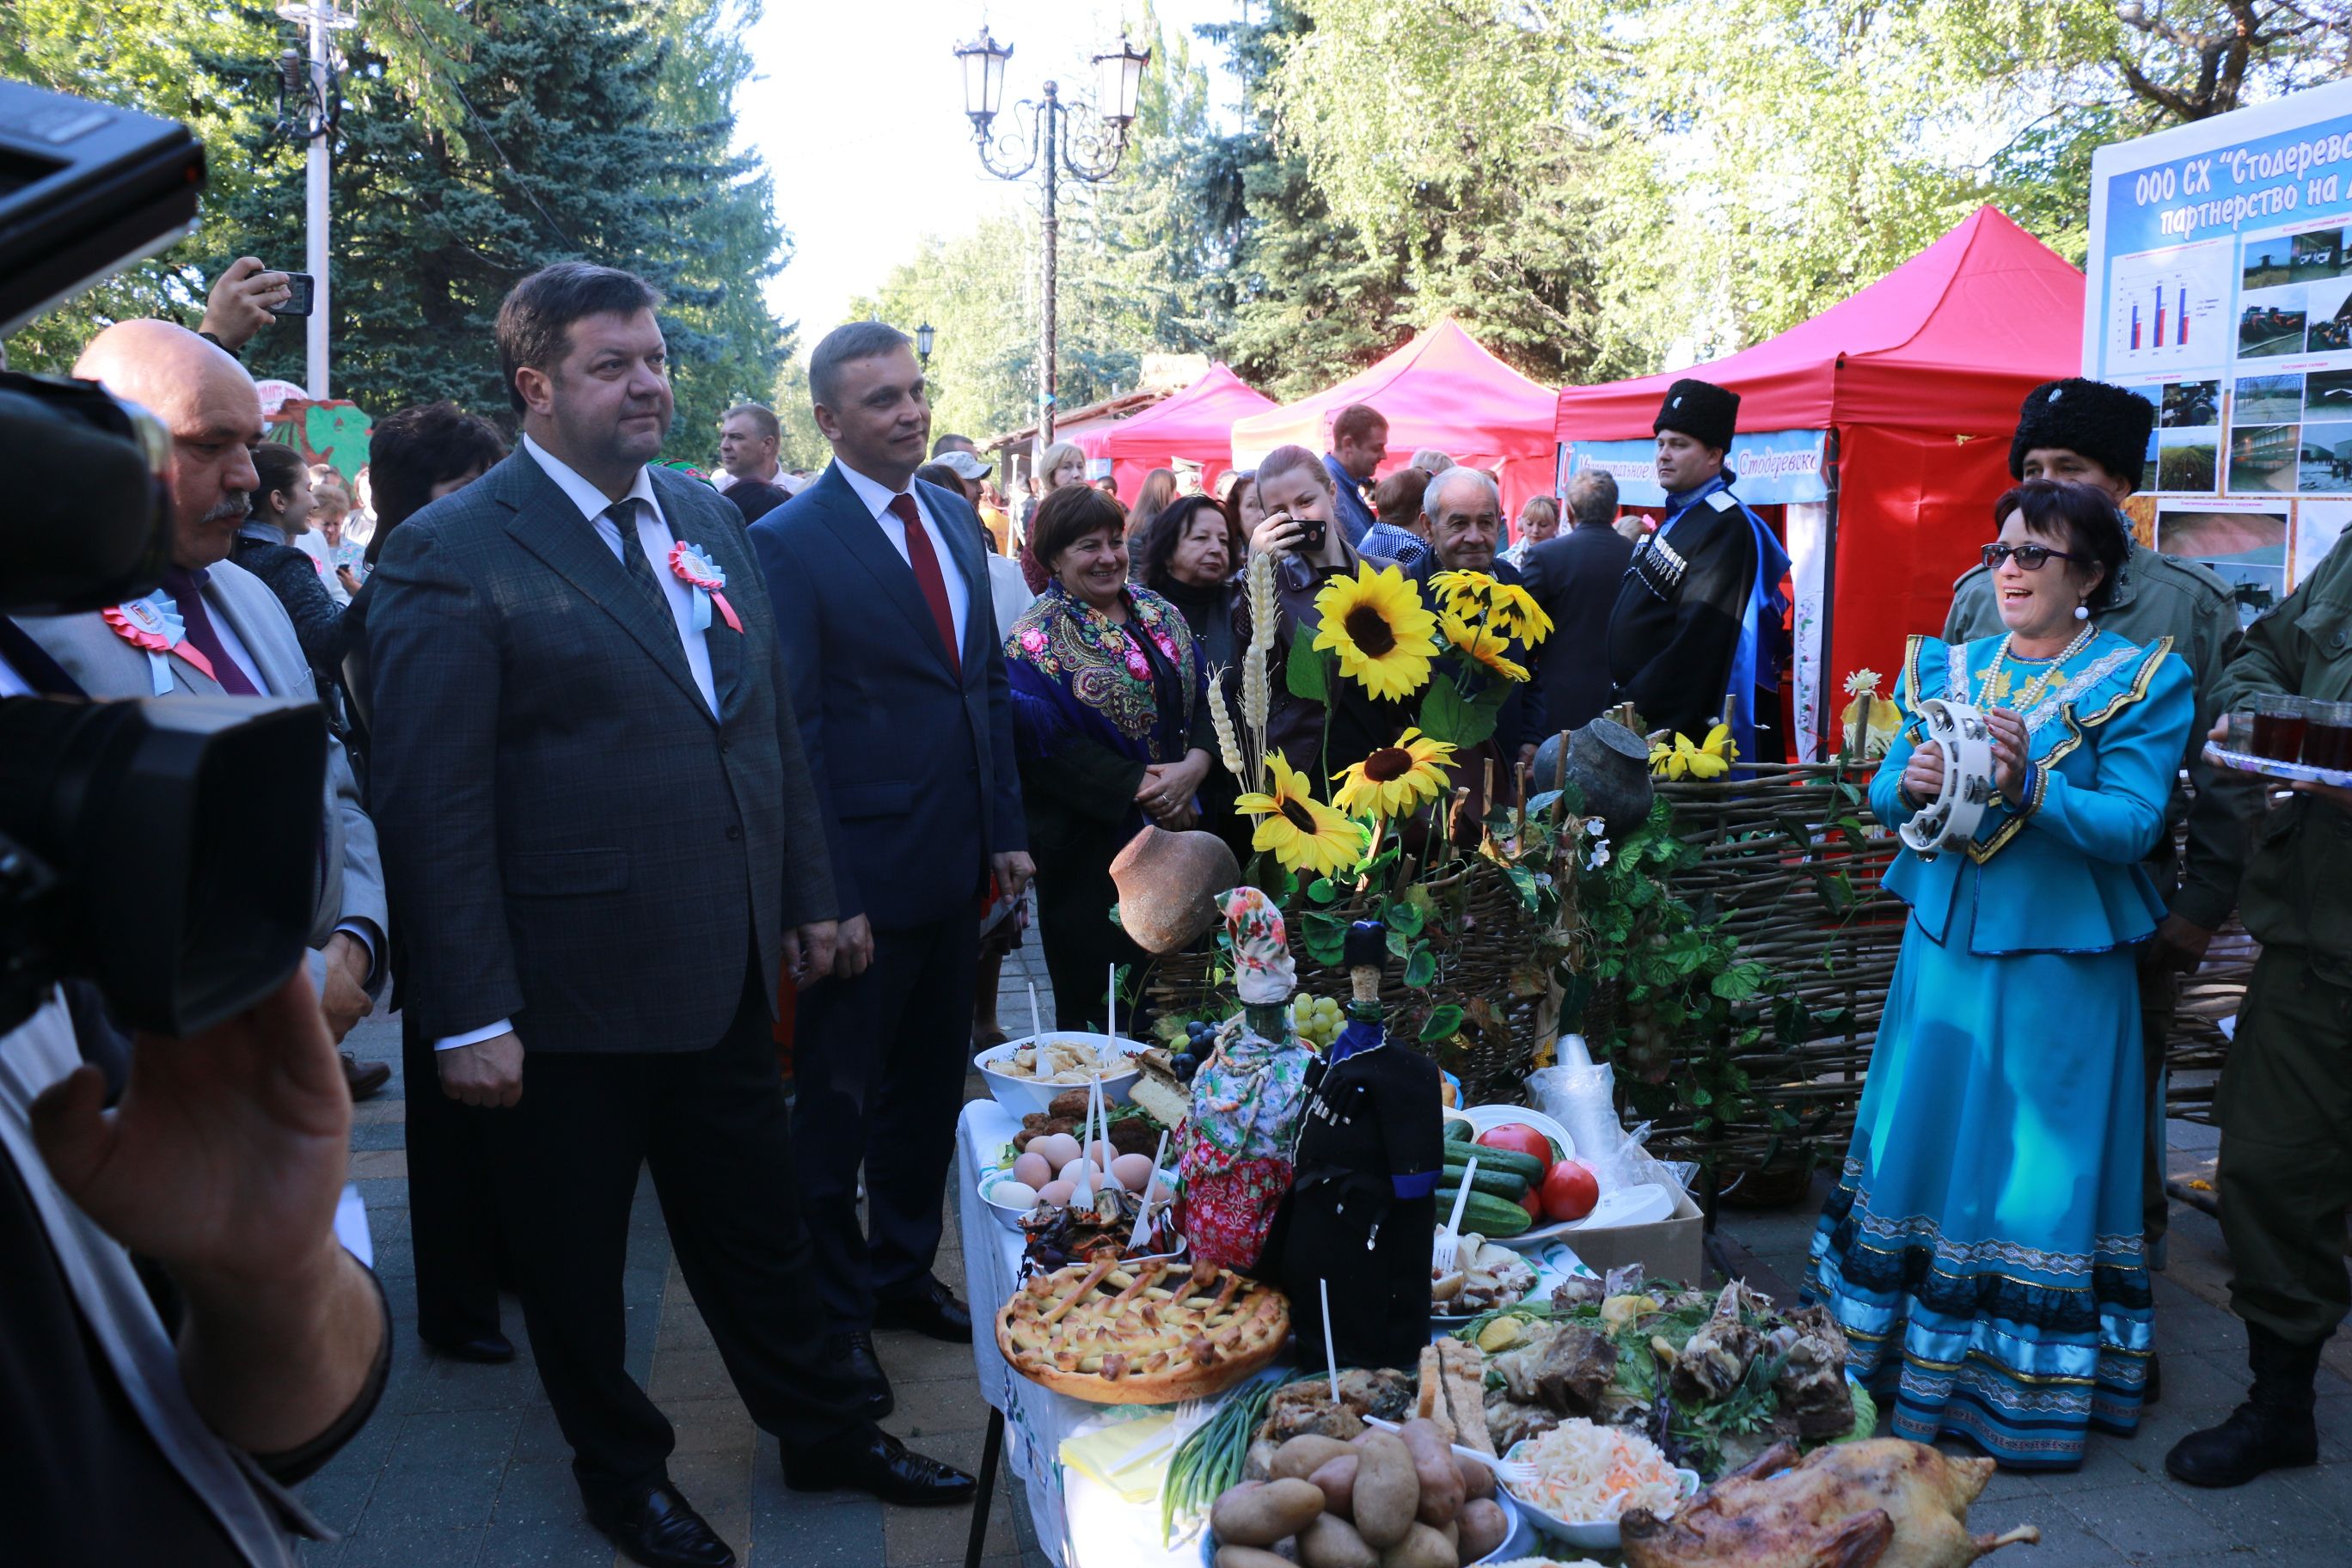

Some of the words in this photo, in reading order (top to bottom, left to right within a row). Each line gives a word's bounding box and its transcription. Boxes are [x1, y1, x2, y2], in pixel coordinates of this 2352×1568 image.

[2136, 167, 2176, 206] ООО
[2183, 157, 2212, 196] СХ
[2160, 183, 2298, 242] партнерство
[2306, 174, 2338, 206] на
